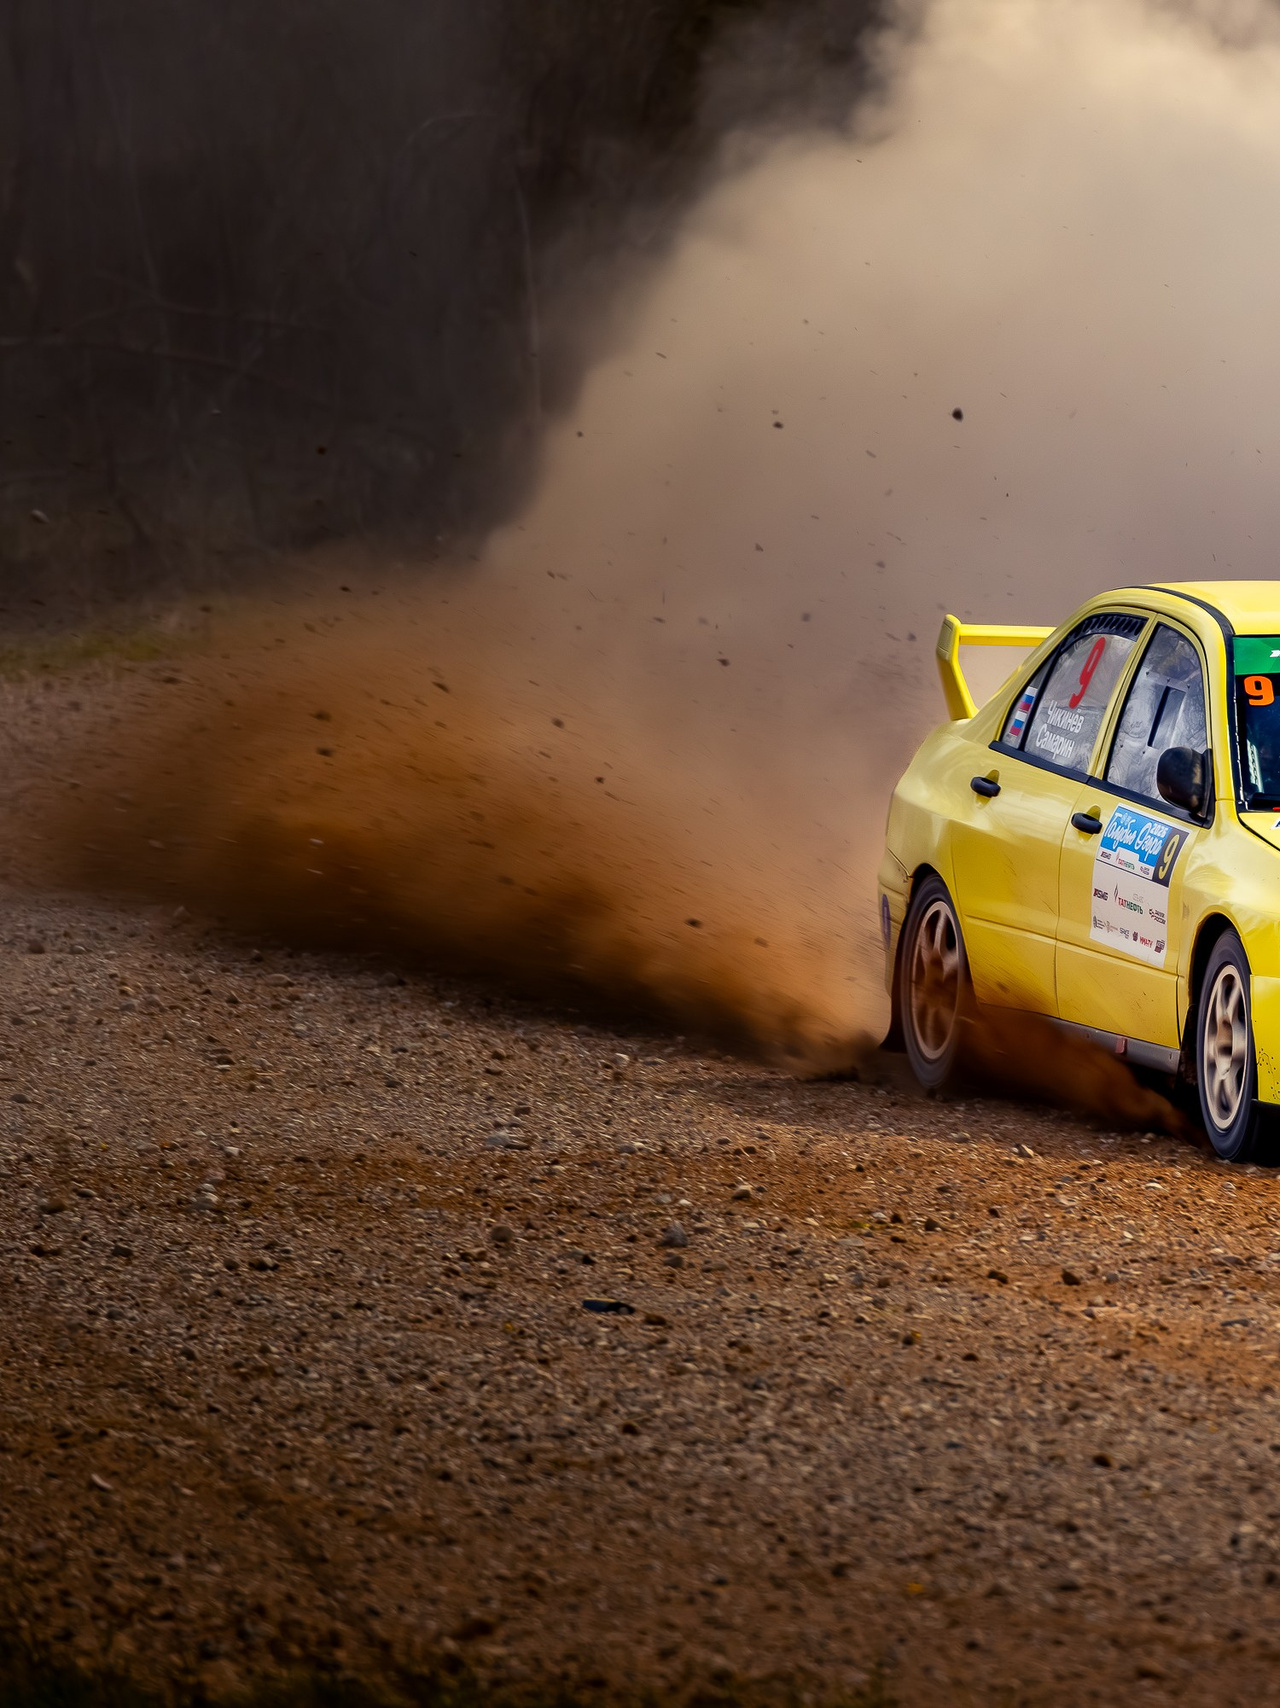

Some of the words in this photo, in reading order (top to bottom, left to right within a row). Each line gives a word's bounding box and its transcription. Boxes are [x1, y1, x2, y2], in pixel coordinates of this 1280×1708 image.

[1069, 637, 1106, 709] 9
[1243, 675, 1275, 706] 9
[1036, 723, 1075, 759] Самарин
[1158, 834, 1180, 880] 9
[1118, 897, 1144, 914] ТАТНЕФТЬ
